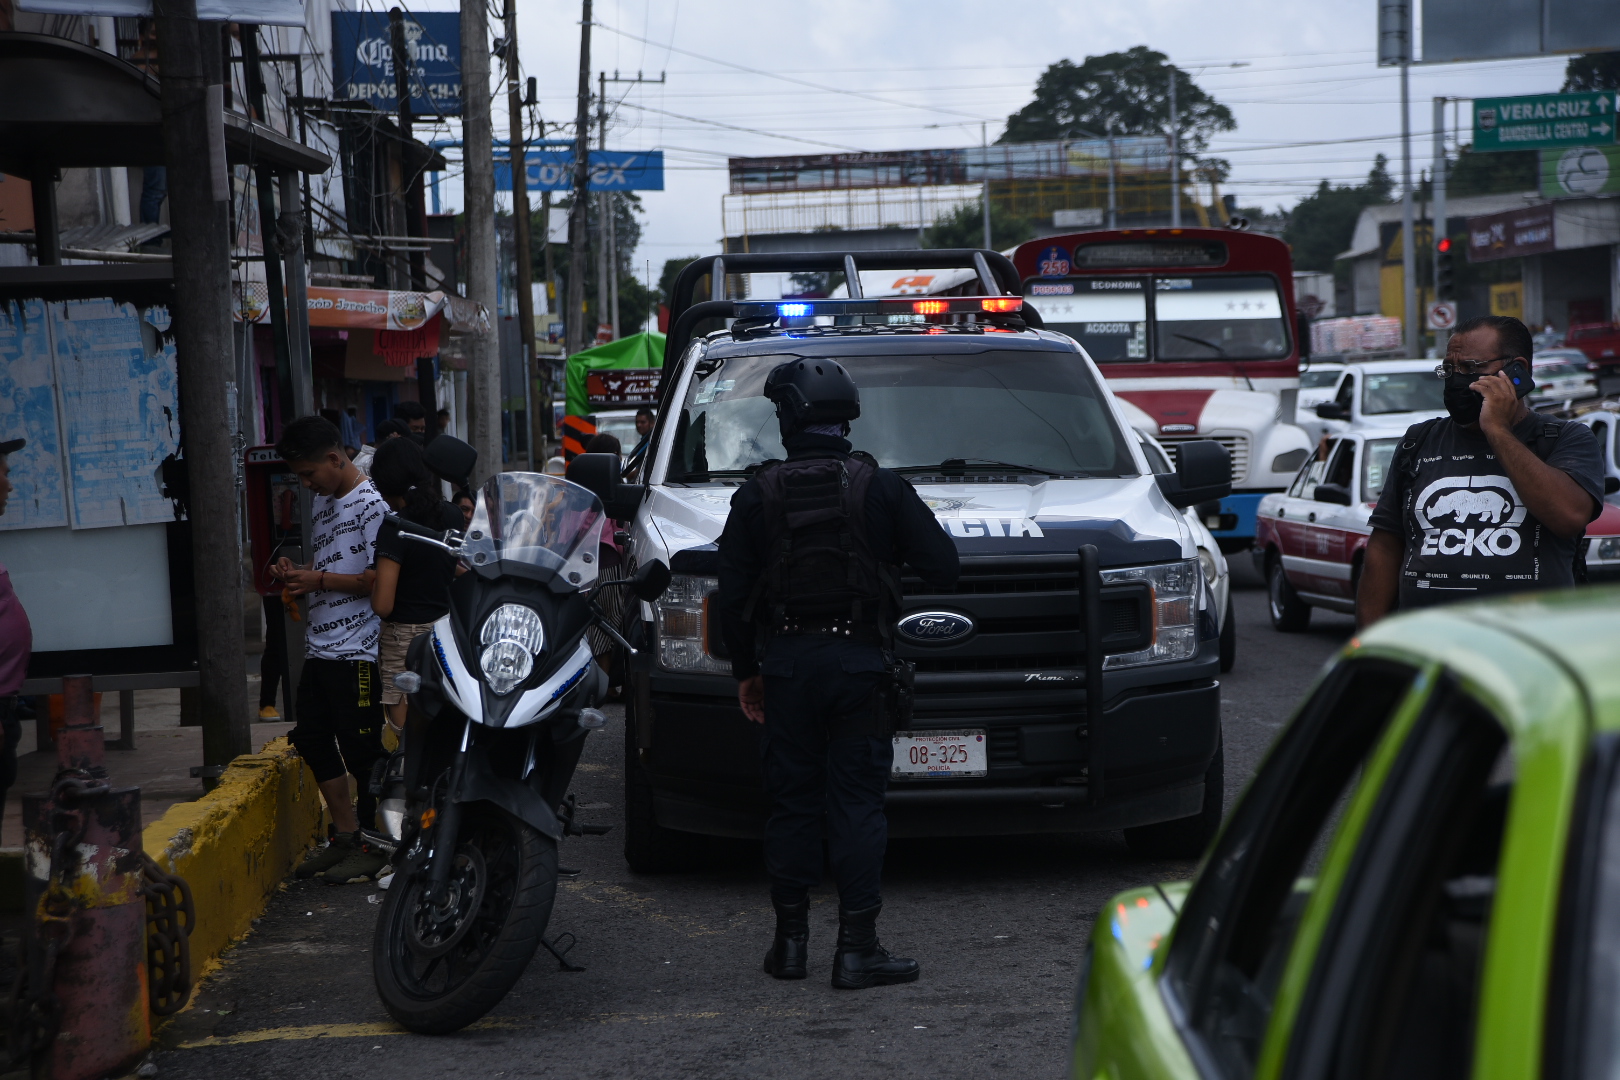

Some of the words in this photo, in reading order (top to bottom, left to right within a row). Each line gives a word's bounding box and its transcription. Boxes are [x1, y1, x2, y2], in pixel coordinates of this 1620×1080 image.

[1500, 100, 1591, 121] VERACRUZ
[1554, 122, 1590, 140] CENTRO
[1041, 259, 1070, 276] 258
[1090, 281, 1142, 290] ECONOMIA
[335, 298, 388, 315] Jarocho
[1085, 322, 1131, 334] ACOCOTA
[1420, 528, 1521, 557] ECKO
[915, 617, 955, 635] Ford
[909, 744, 968, 765] 08-325
